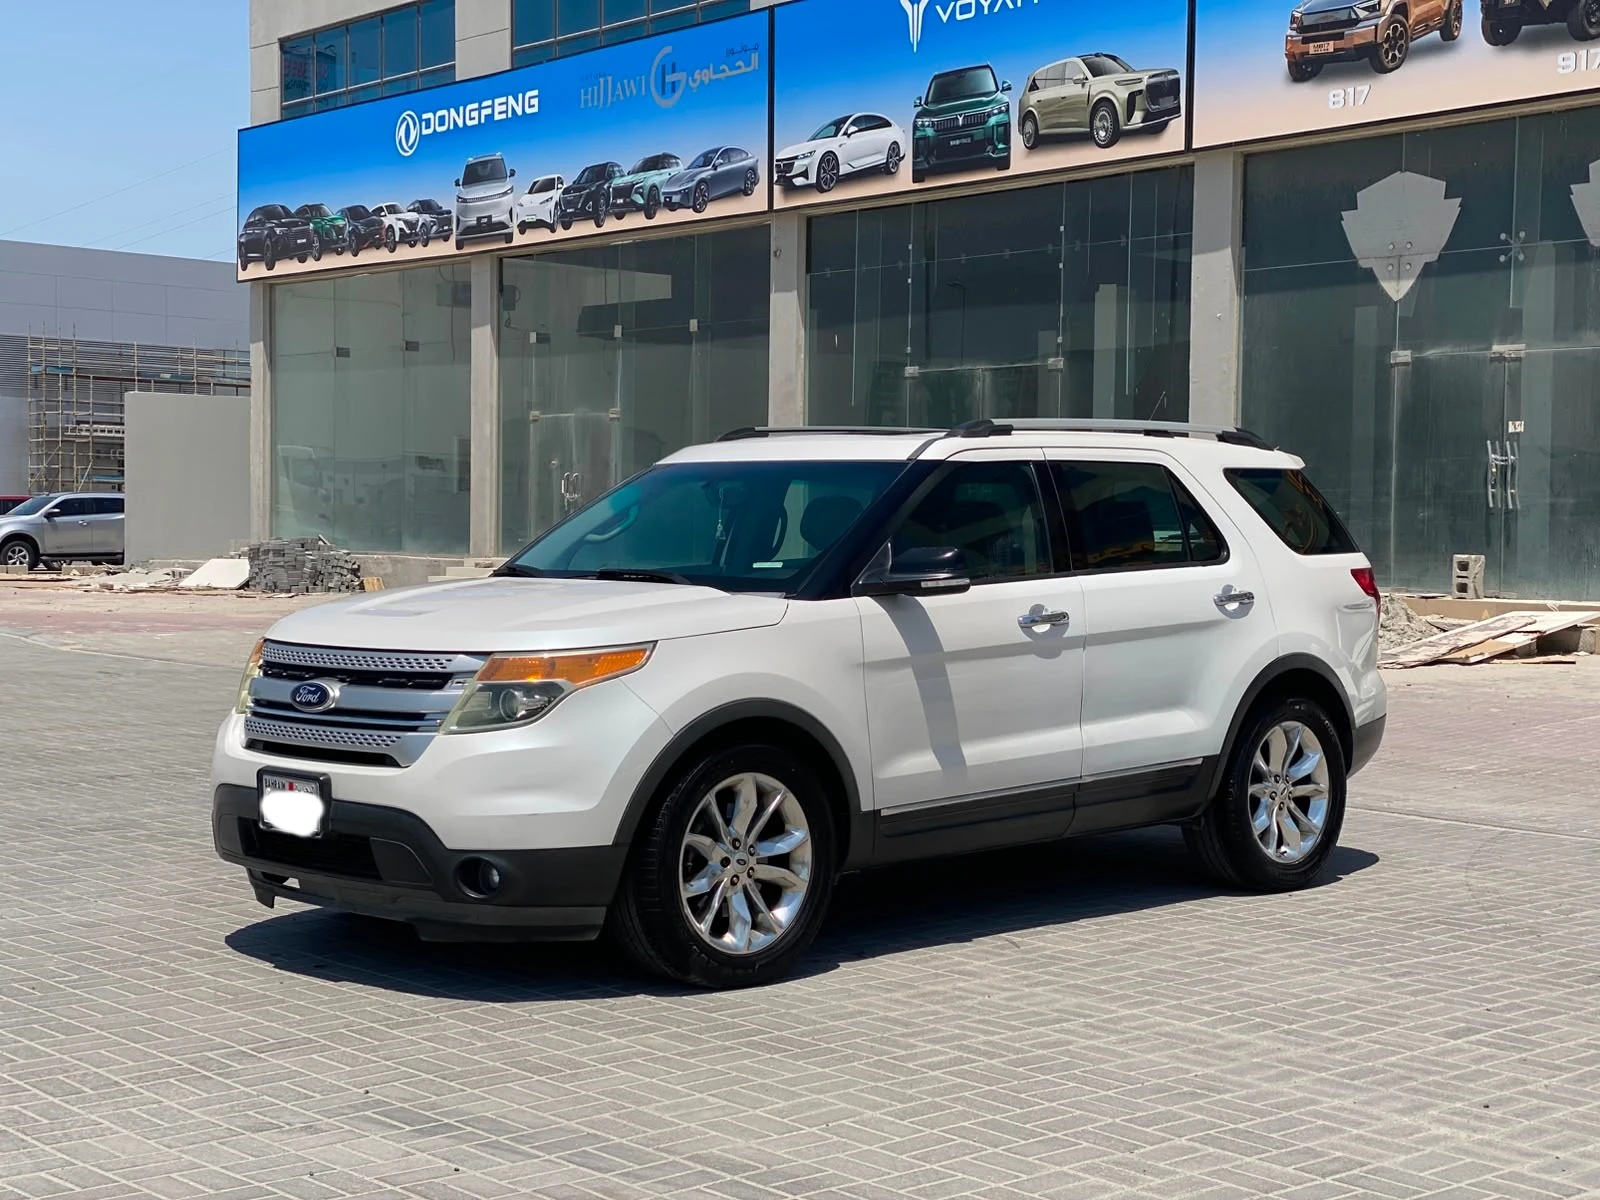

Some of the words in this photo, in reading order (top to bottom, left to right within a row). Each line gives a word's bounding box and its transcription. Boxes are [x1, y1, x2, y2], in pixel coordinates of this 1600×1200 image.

[688, 52, 759, 92] الحجاوي
[580, 75, 646, 110] HIJJAWI
[1328, 84, 1371, 109] 817
[421, 89, 539, 135] DONGFENG
[295, 685, 321, 703] Ford
